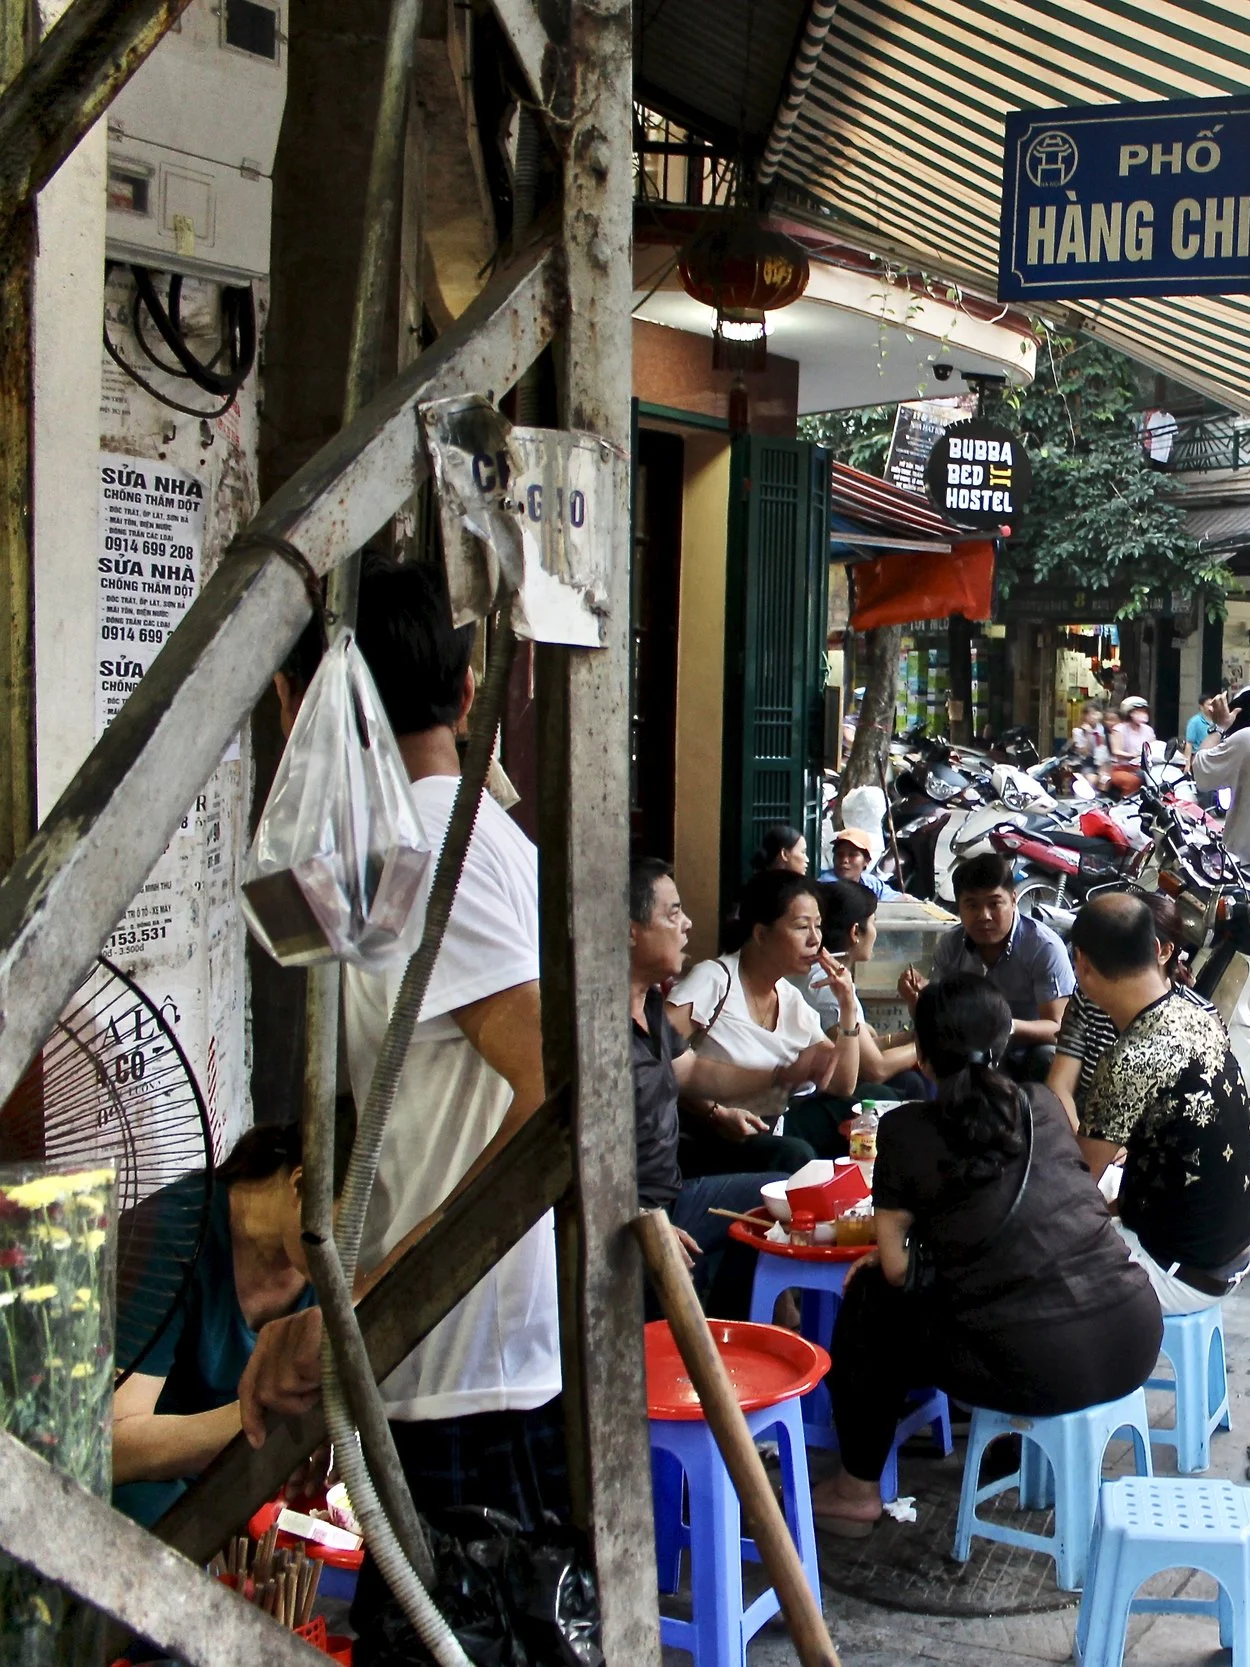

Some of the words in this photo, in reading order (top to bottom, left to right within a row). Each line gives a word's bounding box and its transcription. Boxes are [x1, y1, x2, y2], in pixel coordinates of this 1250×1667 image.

[1118, 124, 1224, 176] PHỐ
[1027, 190, 1154, 265] HÀNG
[949, 438, 1013, 466] BUBBA
[101, 463, 147, 490] SỬA
[155, 476, 203, 499] NHÀ
[947, 463, 983, 486] BED
[104, 487, 141, 503] CHỐNG
[145, 494, 174, 508] THẤM
[946, 487, 1013, 512] HOSTEL
[105, 536, 138, 553] 0914
[143, 540, 166, 557] 699
[169, 544, 193, 560] 208
[98, 553, 144, 577] SỬA
[151, 563, 195, 582] NHÀ
[101, 577, 138, 591] CHỐNG
[142, 580, 171, 595] THẤM
[174, 585, 193, 599] DỘT
[102, 625, 135, 641] 0914
[139, 629, 163, 644] 699
[100, 655, 144, 678] SỬA
[102, 680, 138, 692] CHỐN
[105, 926, 166, 948] .153.531
